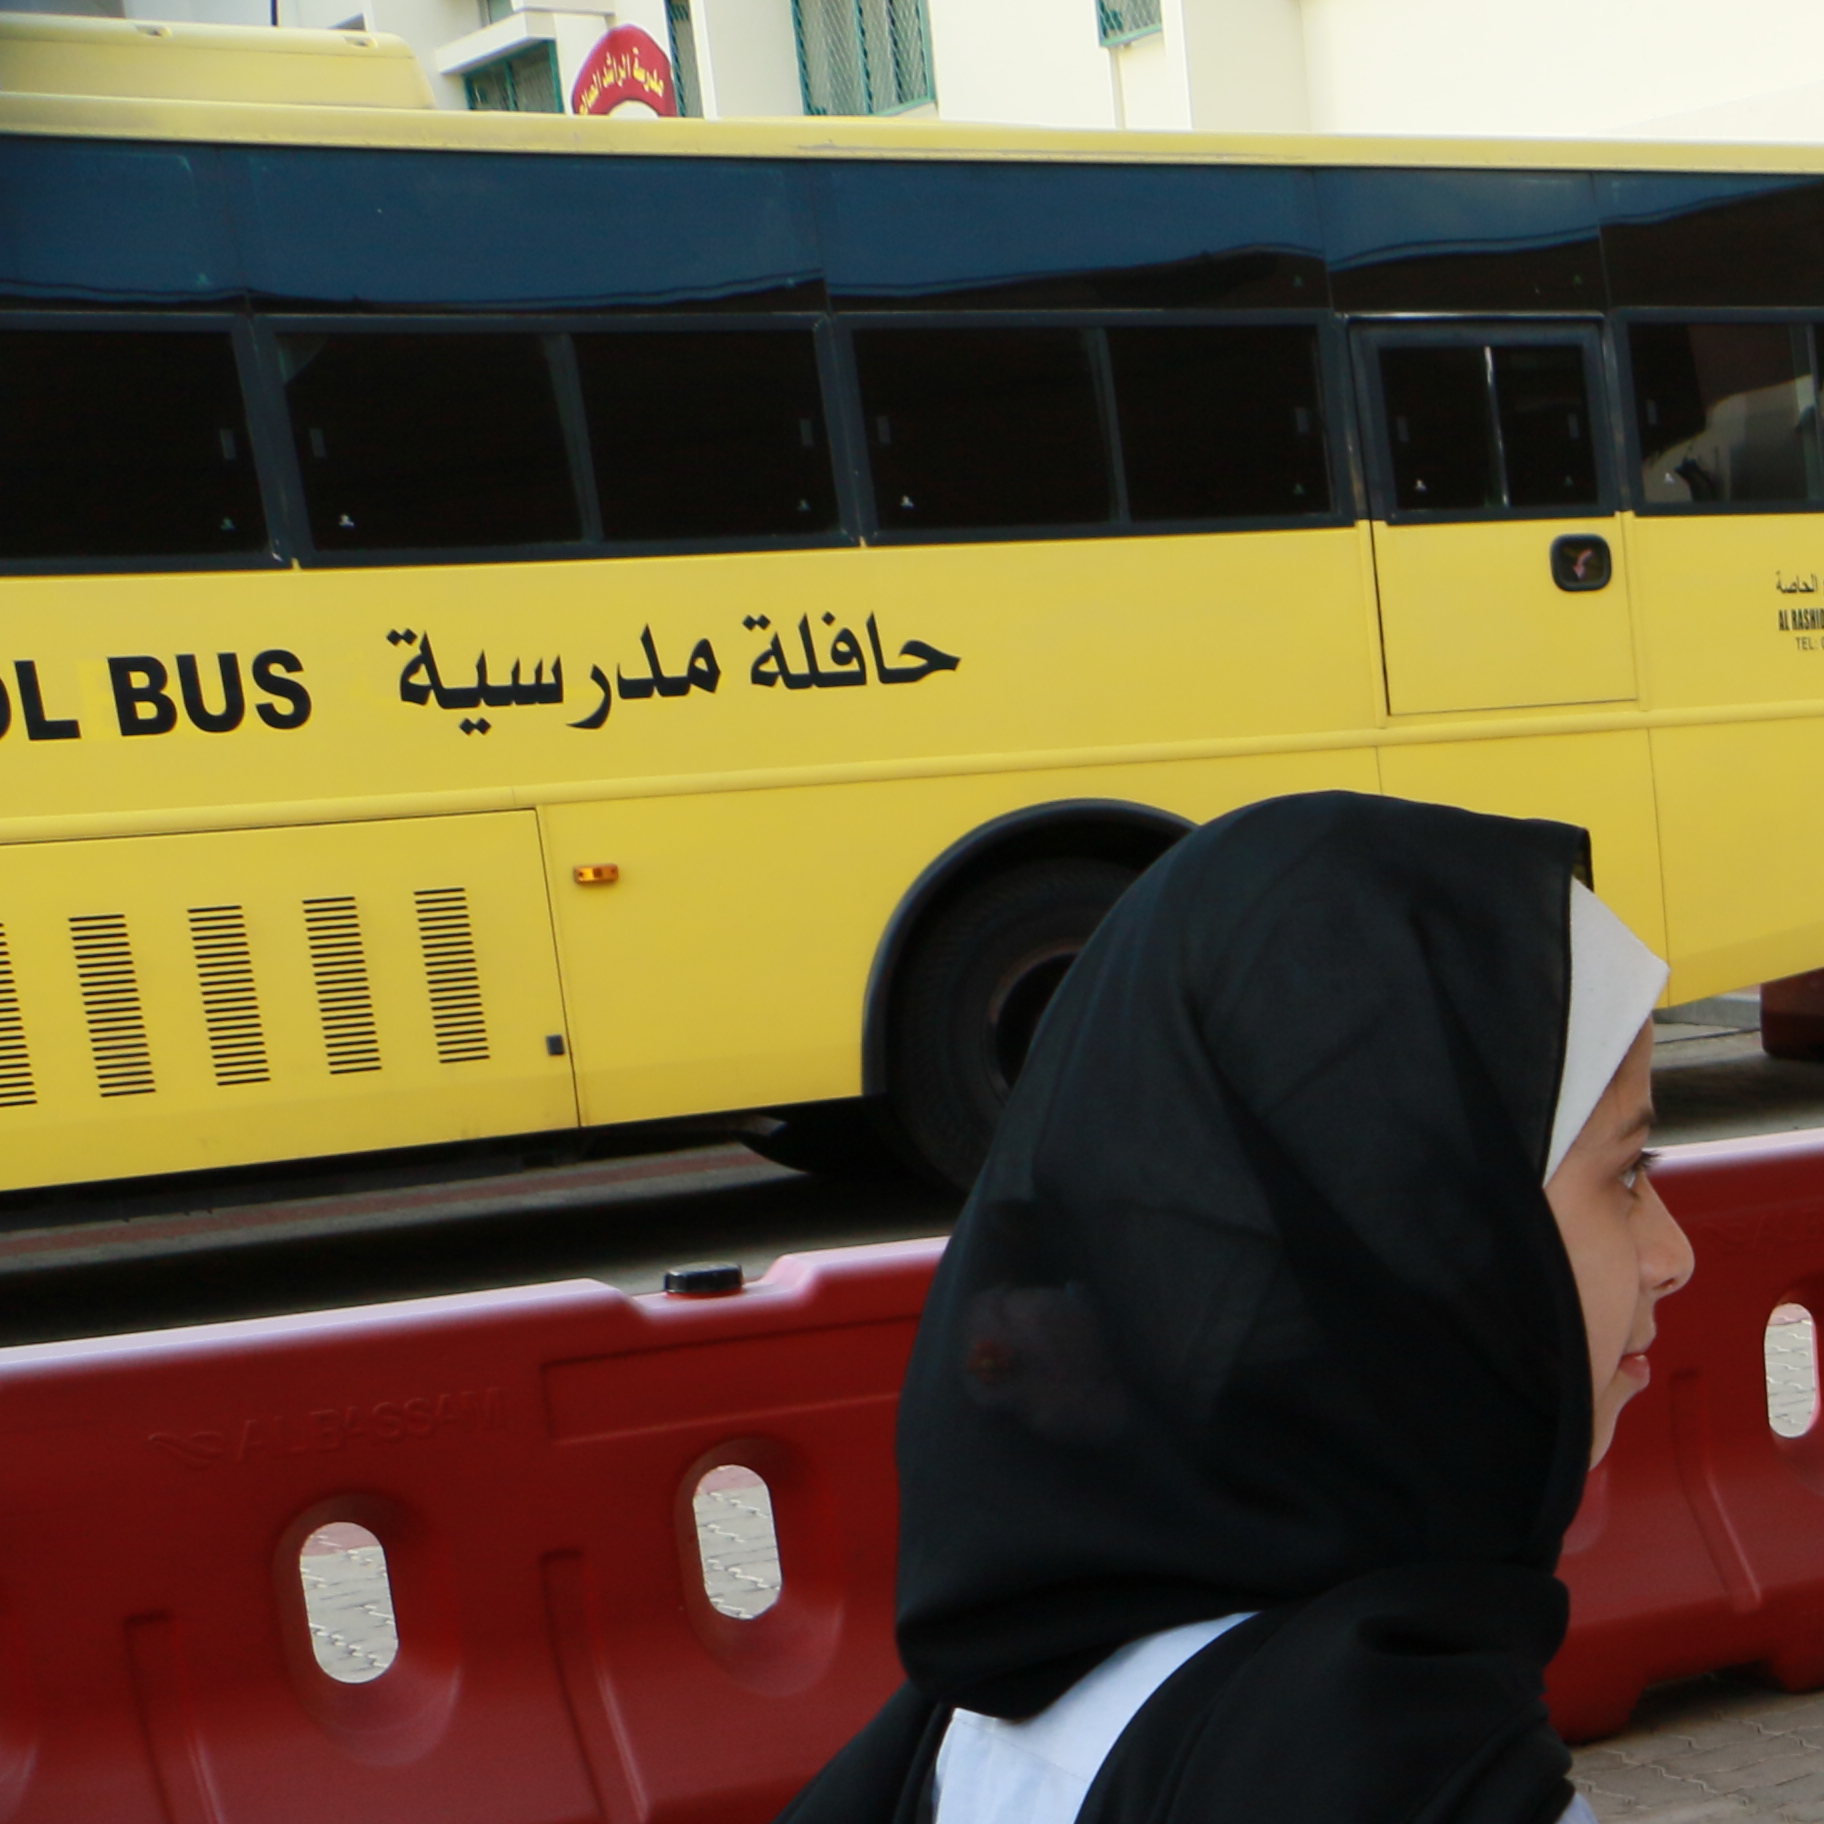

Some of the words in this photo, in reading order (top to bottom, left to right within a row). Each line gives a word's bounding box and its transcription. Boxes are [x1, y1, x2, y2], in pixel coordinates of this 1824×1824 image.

[1776, 570, 1818, 594] الخاصة
[1779, 609, 1789, 631] AL
[386, 623, 721, 736] مدرسية
[742, 611, 961, 690] حافلة
[108, 649, 312, 736] BUS
